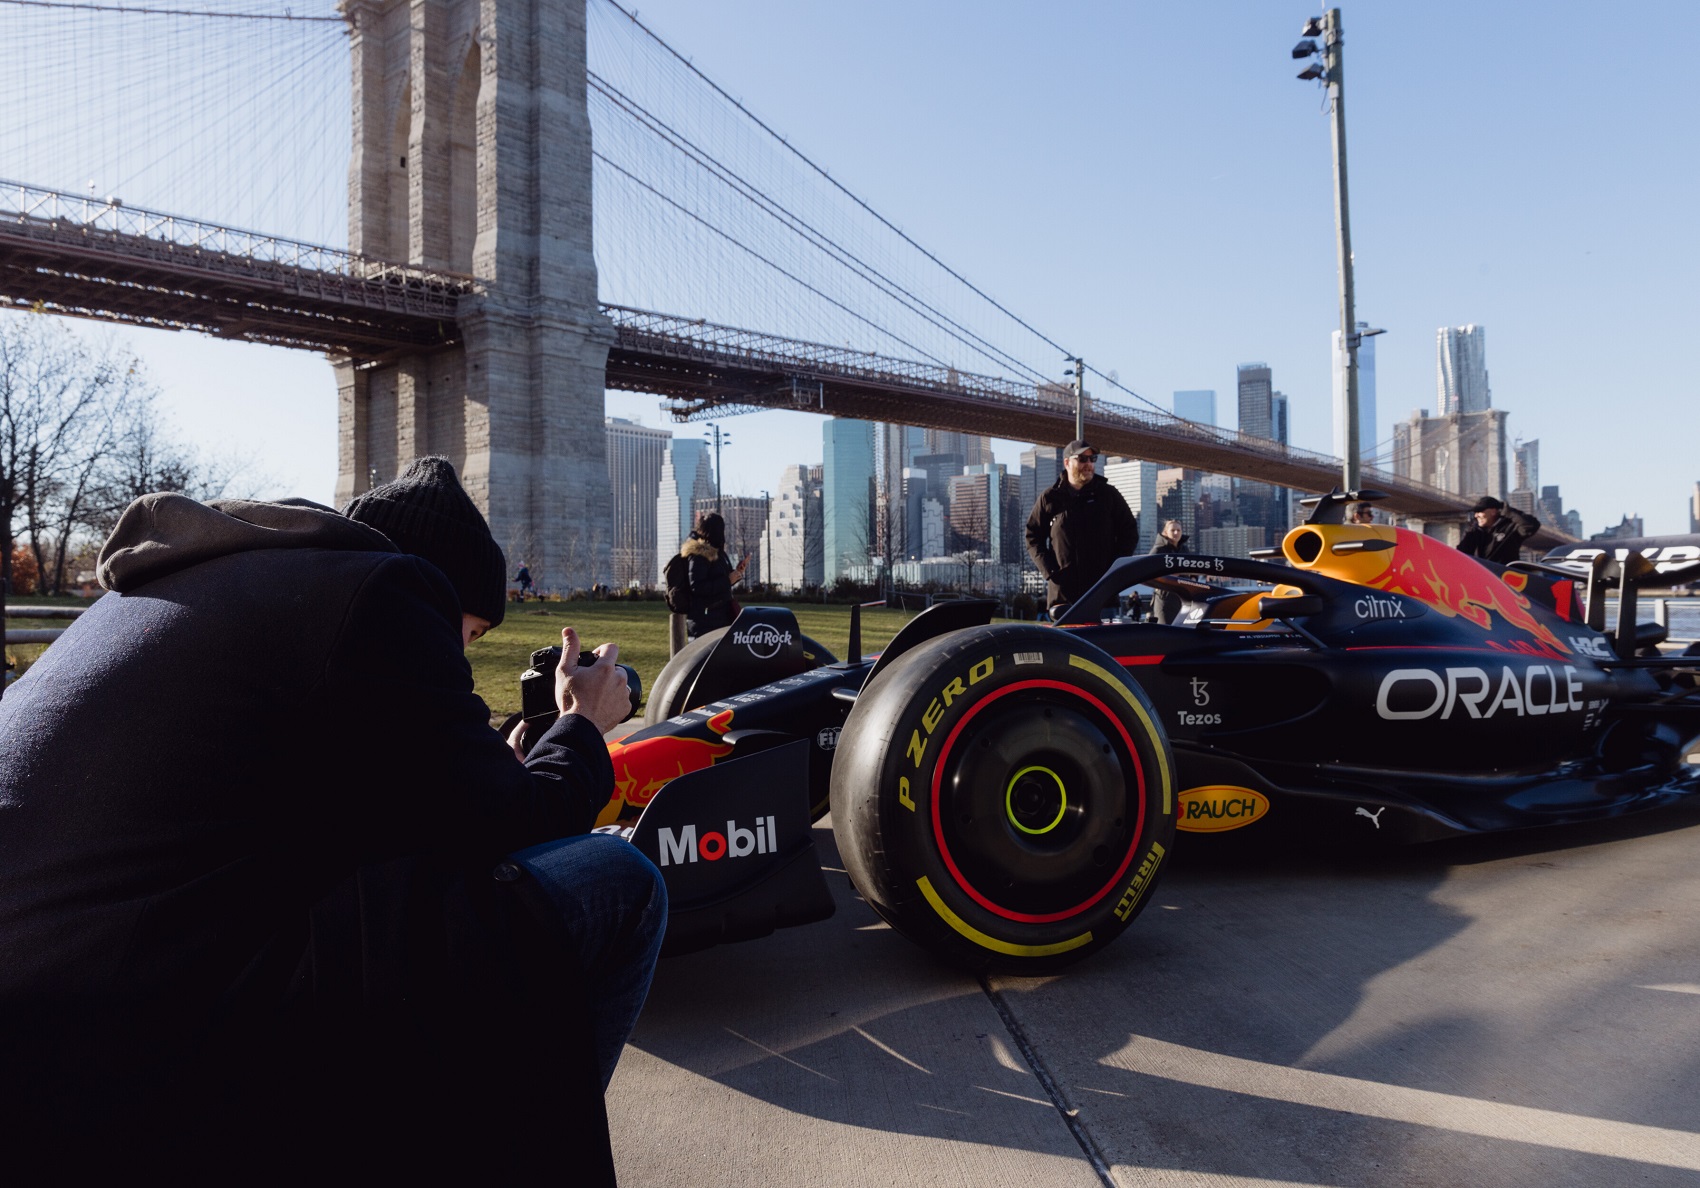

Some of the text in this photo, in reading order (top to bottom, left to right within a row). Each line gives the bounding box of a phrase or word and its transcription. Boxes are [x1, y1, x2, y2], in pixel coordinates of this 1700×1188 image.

[1176, 556, 1211, 569] Tezos
[1355, 595, 1406, 618] citrix
[733, 630, 792, 646] Hard Rock
[1376, 665, 1584, 720] ORACLE
[1177, 710, 1222, 726] Tezos
[899, 656, 994, 812] P ZERO
[1186, 798, 1256, 819] RAUCH
[657, 815, 778, 867] Mobil
[1113, 841, 1166, 923] PIRELLI
